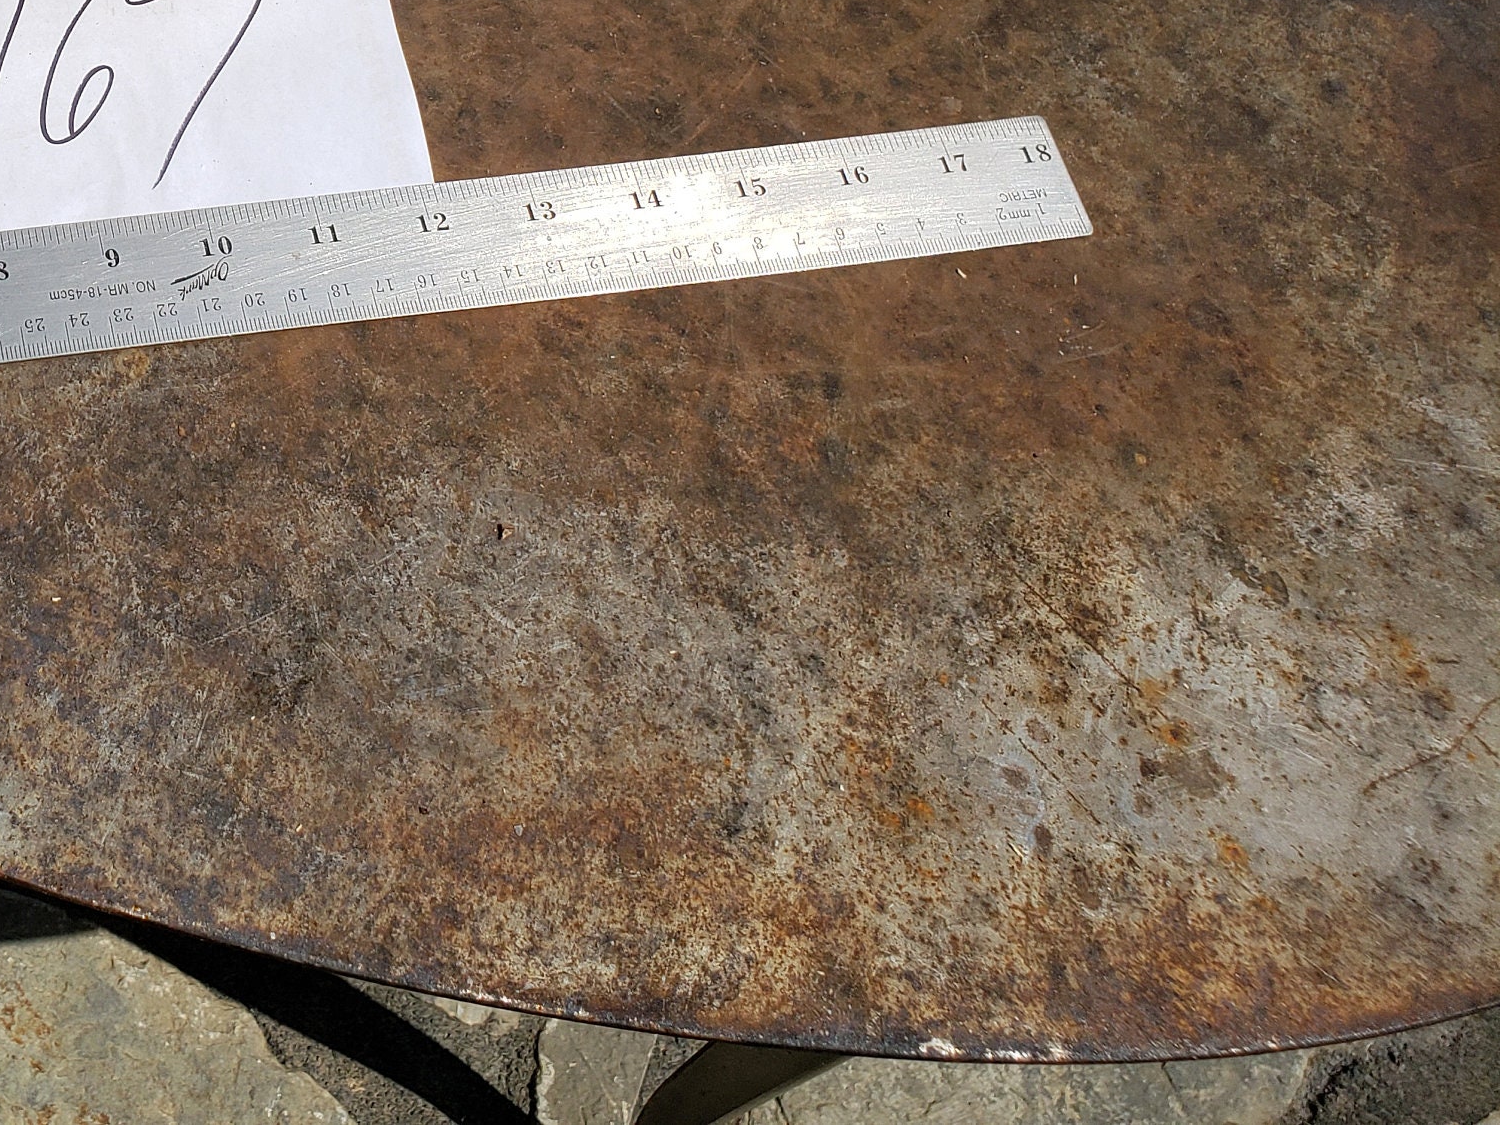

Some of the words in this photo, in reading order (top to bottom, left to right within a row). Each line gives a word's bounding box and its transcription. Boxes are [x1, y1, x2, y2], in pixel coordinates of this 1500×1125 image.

[999, 188, 1047, 202] METRIC
[105, 248, 120, 268] 9
[199, 235, 233, 257] 10
[308, 224, 342, 245] 11
[416, 212, 450, 233] 12
[524, 201, 556, 221] 13
[629, 189, 663, 210] 14
[736, 176, 767, 198] 15
[837, 165, 870, 187] 16
[938, 153, 969, 174] 17
[1019, 143, 1052, 164] 18
[1038, 203, 1047, 215] 1
[956, 212, 967, 225] 3
[997, 207, 1007, 221] 2
[1008, 208, 1031, 219] mm
[876, 222, 887, 235] 5
[916, 217, 926, 230] 4
[796, 231, 806, 245] 7
[835, 227, 845, 241] 6
[712, 241, 722, 255] 9
[753, 236, 764, 250] 8
[630, 250, 650, 264] 11
[673, 245, 693, 260] 10
[546, 259, 567, 274] 13
[587, 254, 608, 269] 12
[461, 268, 481, 283] 15
[503, 264, 523, 278] 14
[132, 279, 156, 293] NO.
[376, 278, 395, 293] 17
[417, 273, 437, 289] 16
[49, 283, 129, 301] MR-18-45cm
[289, 287, 308, 303] 19
[331, 282, 351, 298] 18
[202, 297, 222, 312] 21
[244, 292, 265, 307] 20
[113, 307, 134, 322] 23
[157, 302, 178, 318] 22
[24, 317, 46, 333] 25
[69, 312, 90, 328] 24
